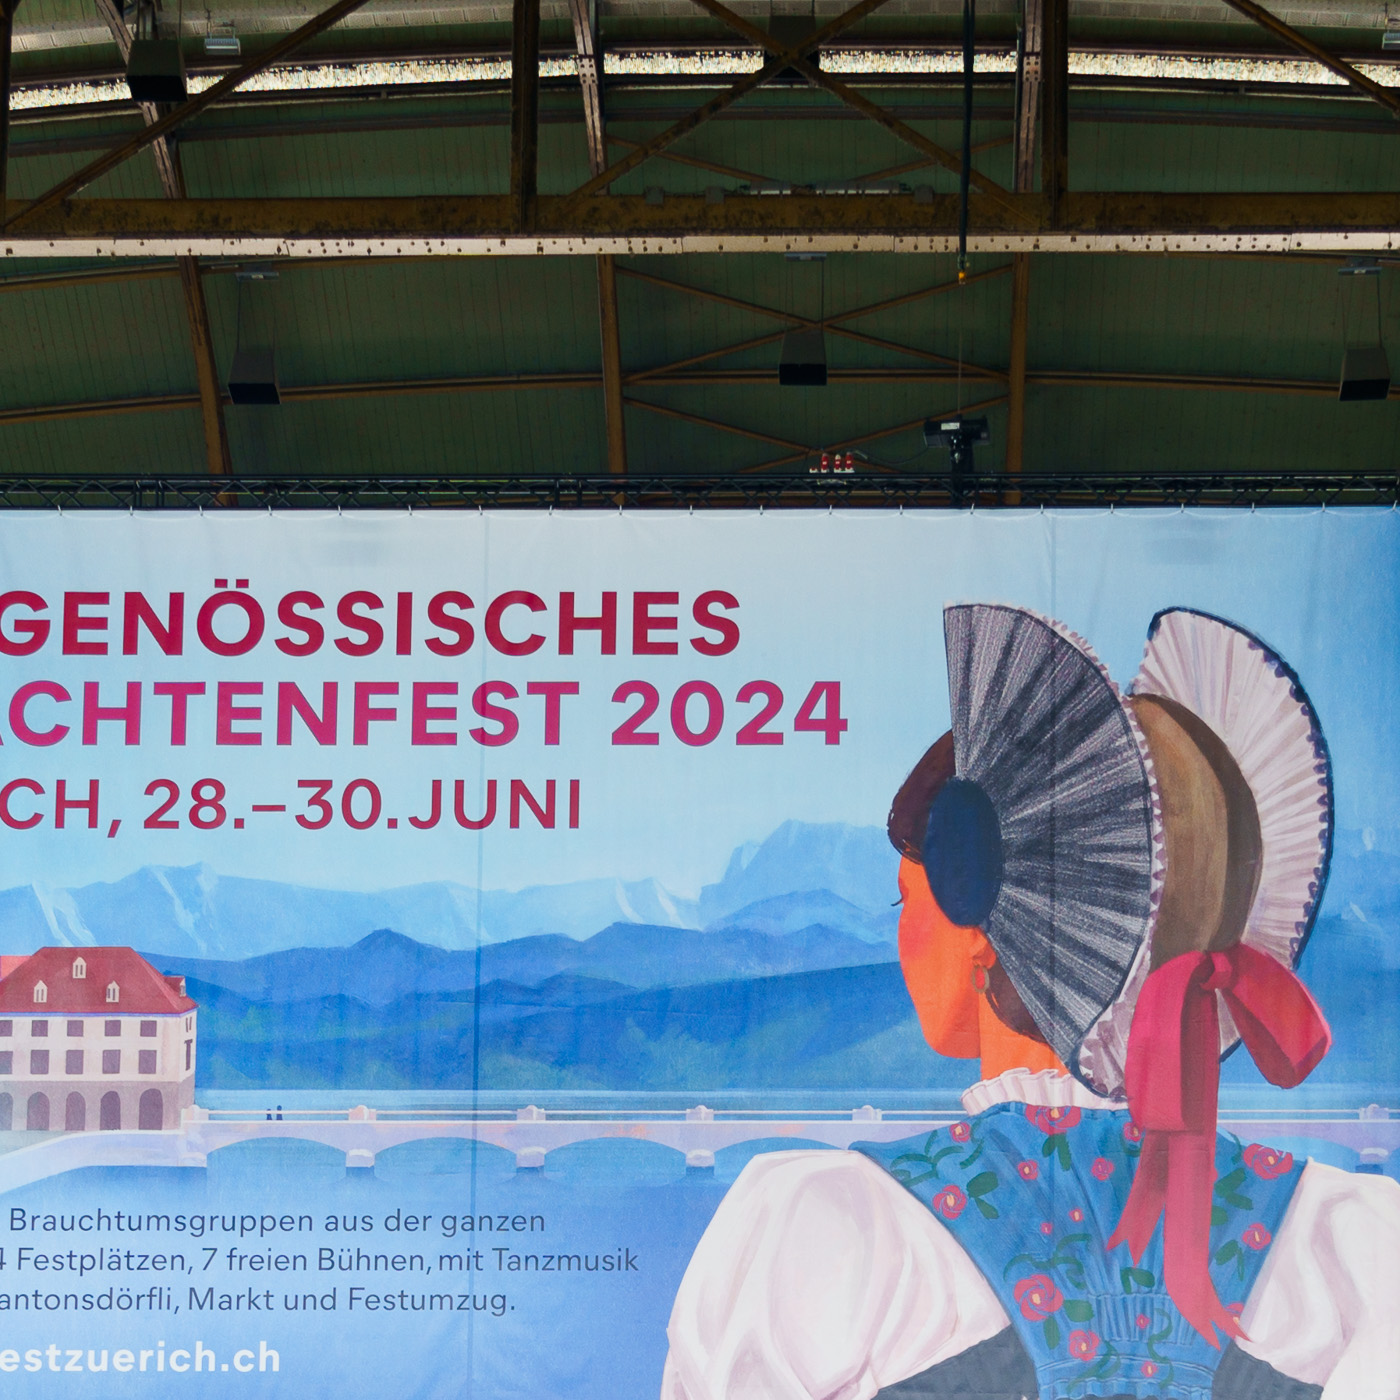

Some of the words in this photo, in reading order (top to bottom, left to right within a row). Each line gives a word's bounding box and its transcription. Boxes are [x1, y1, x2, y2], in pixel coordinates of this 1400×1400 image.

[612, 680, 848, 746] 2024
[11, 1208, 312, 1237] Brauchtumsgruppen
[325, 1216, 373, 1231] aus
[385, 1209, 432, 1231] der
[442, 1216, 544, 1237] ganzen
[18, 1248, 192, 1276] Festplätzen,
[203, 1248, 217, 1270] 7
[227, 1248, 306, 1271] freien
[319, 1248, 431, 1275] Bühnen,
[440, 1248, 483, 1271] mit
[492, 1248, 638, 1271] Tanzmusik
[189, 1287, 274, 1310] Markt
[285, 1287, 336, 1310] und
[350, 1287, 514, 1316] Festumzug.
